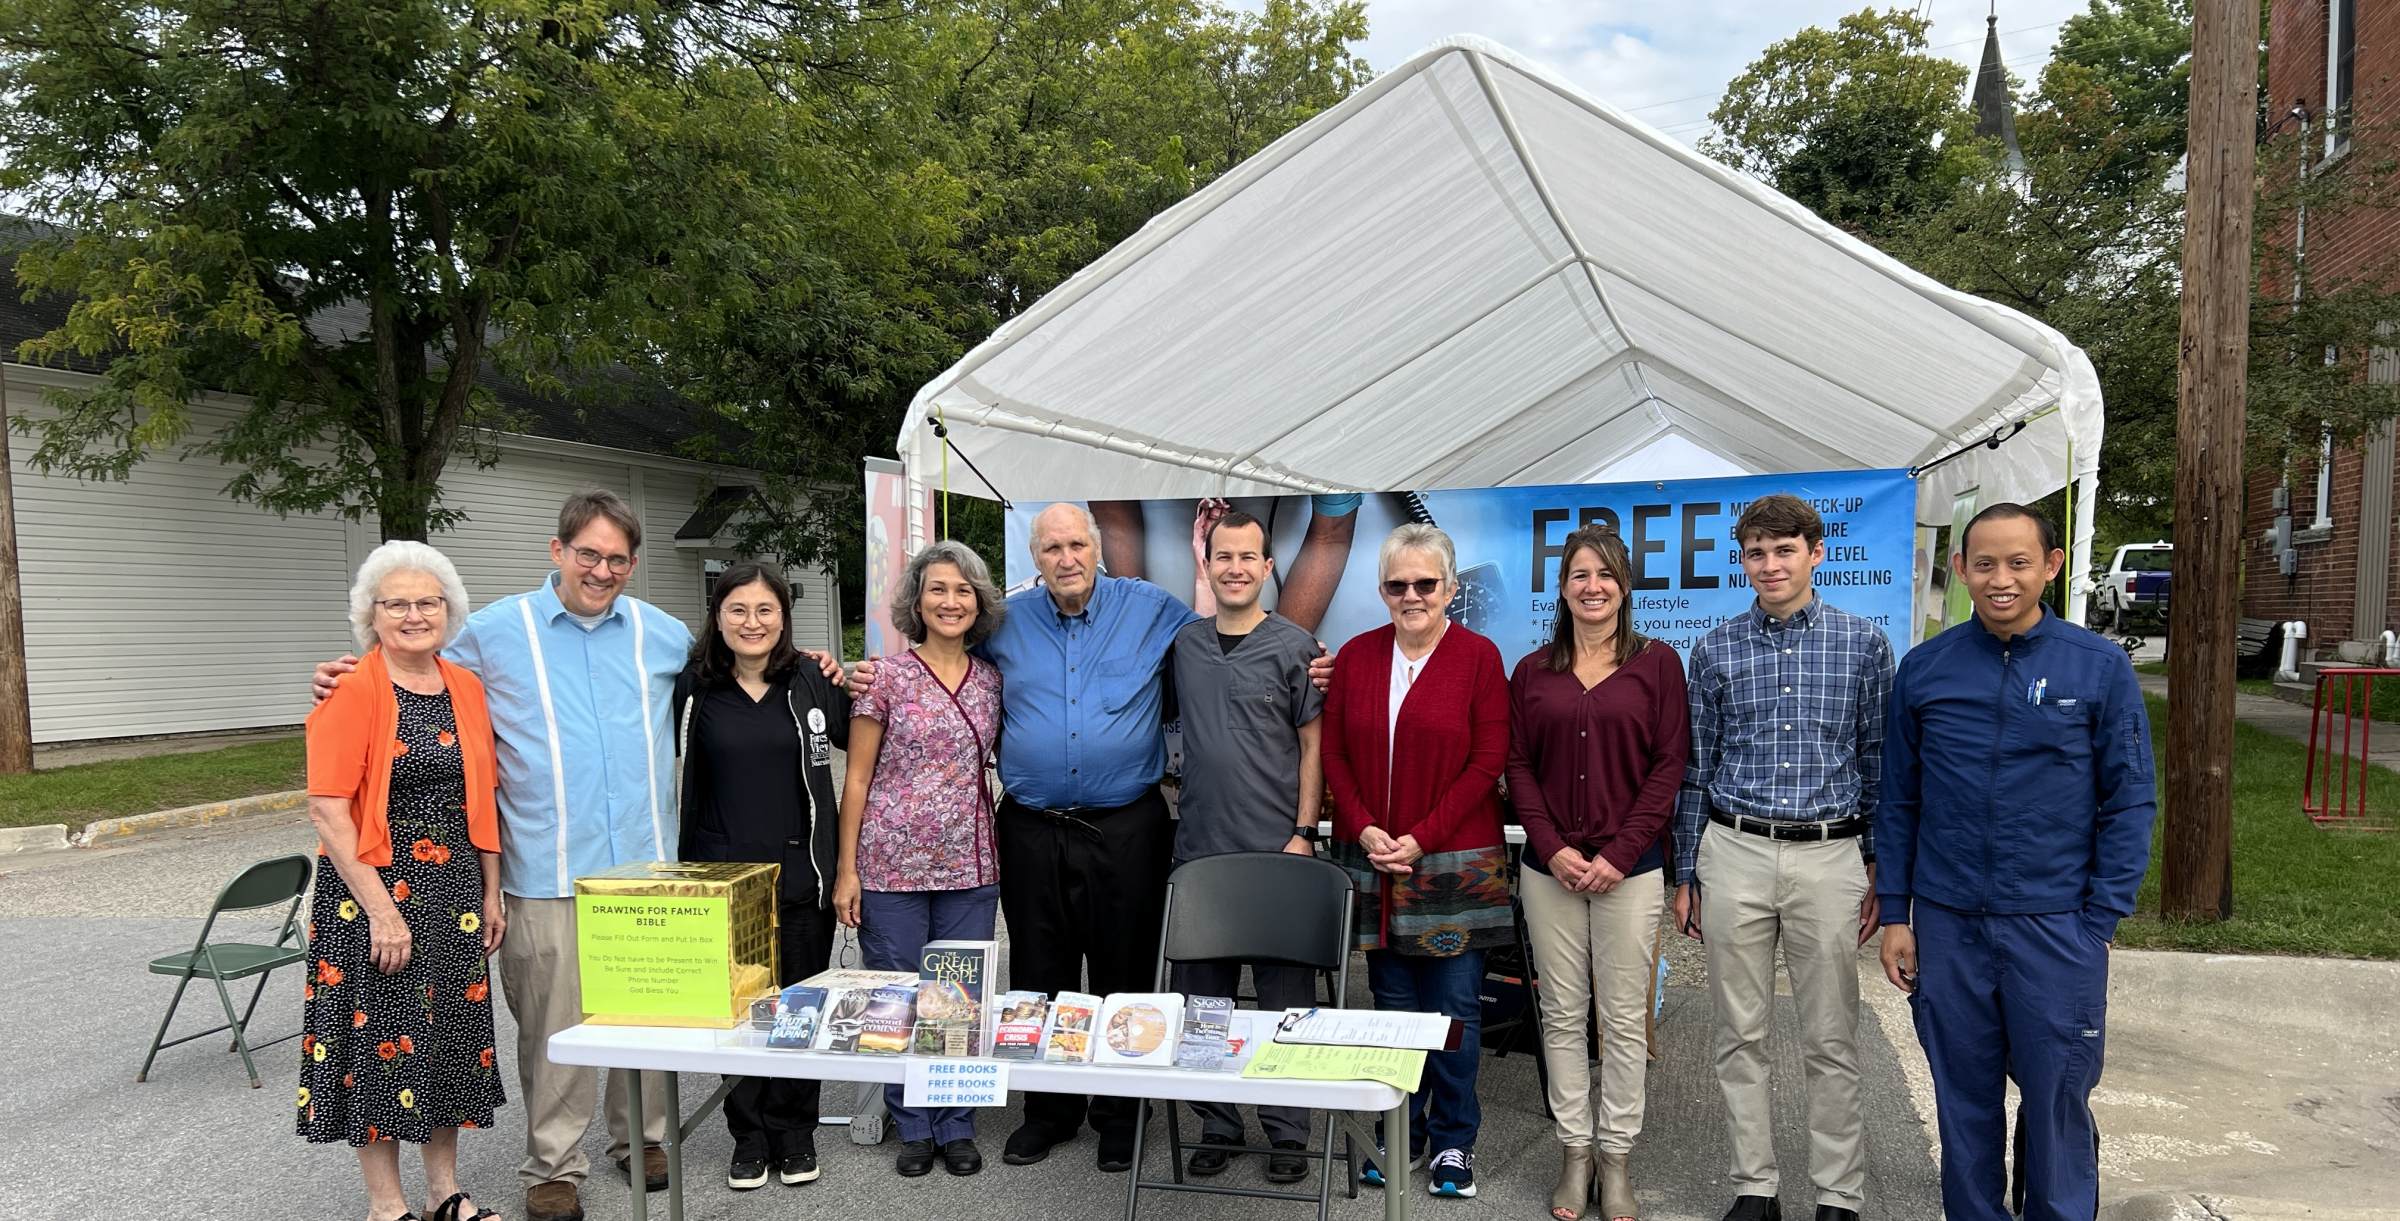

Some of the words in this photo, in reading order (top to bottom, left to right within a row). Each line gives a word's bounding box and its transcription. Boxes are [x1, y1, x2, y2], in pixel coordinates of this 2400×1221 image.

[1804, 497, 1863, 514] ECK-UP
[1827, 546, 1869, 562] LEVEL
[1812, 570, 1892, 588] OUNSELING
[1631, 596, 1690, 612] Lifestyle
[1644, 619, 1671, 632] you
[1675, 616, 1712, 629] need
[592, 905, 644, 915] DRAWING
[647, 906, 668, 915] FOR
[671, 907, 710, 916] FAMILY
[636, 918, 667, 927] BIBLE
[591, 933, 613, 941] Please
[626, 934, 640, 942] Out
[641, 935, 659, 943] Form
[588, 954, 601, 962] You
[666, 956, 693, 964] Present
[923, 953, 983, 973] GREAT
[937, 969, 978, 988] HOPE
[1192, 997, 1226, 1008] SIGNS
[929, 1064, 955, 1073] FREE
[958, 1064, 997, 1073] BOOKS
[928, 1079, 954, 1088] FREE
[957, 1079, 996, 1088] BOOKS
[927, 1094, 953, 1103] FREE
[956, 1094, 994, 1103] BOOKS
